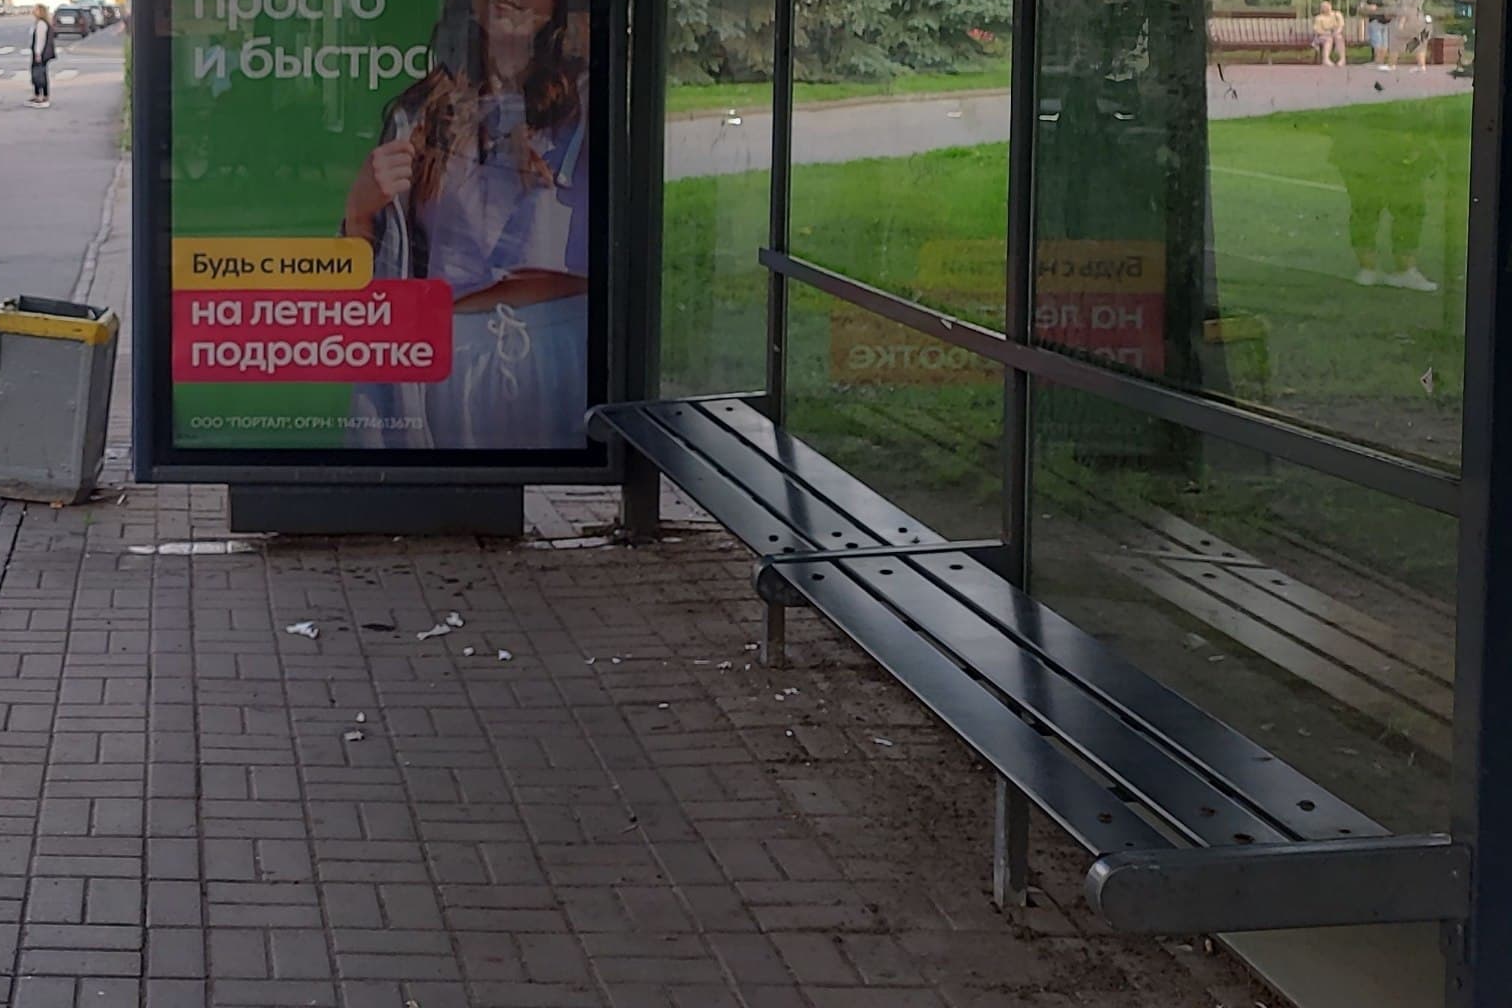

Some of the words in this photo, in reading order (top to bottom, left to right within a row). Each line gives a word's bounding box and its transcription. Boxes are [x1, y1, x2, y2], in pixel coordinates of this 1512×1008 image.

[194, 47, 225, 79] и
[240, 37, 433, 90] быстро
[192, 253, 255, 278] Будь
[260, 257, 274, 274] с
[280, 257, 353, 275] нами
[191, 300, 242, 326] на
[249, 292, 392, 326] летней
[191, 335, 434, 374] подработке
[191, 416, 224, 429] ООО
